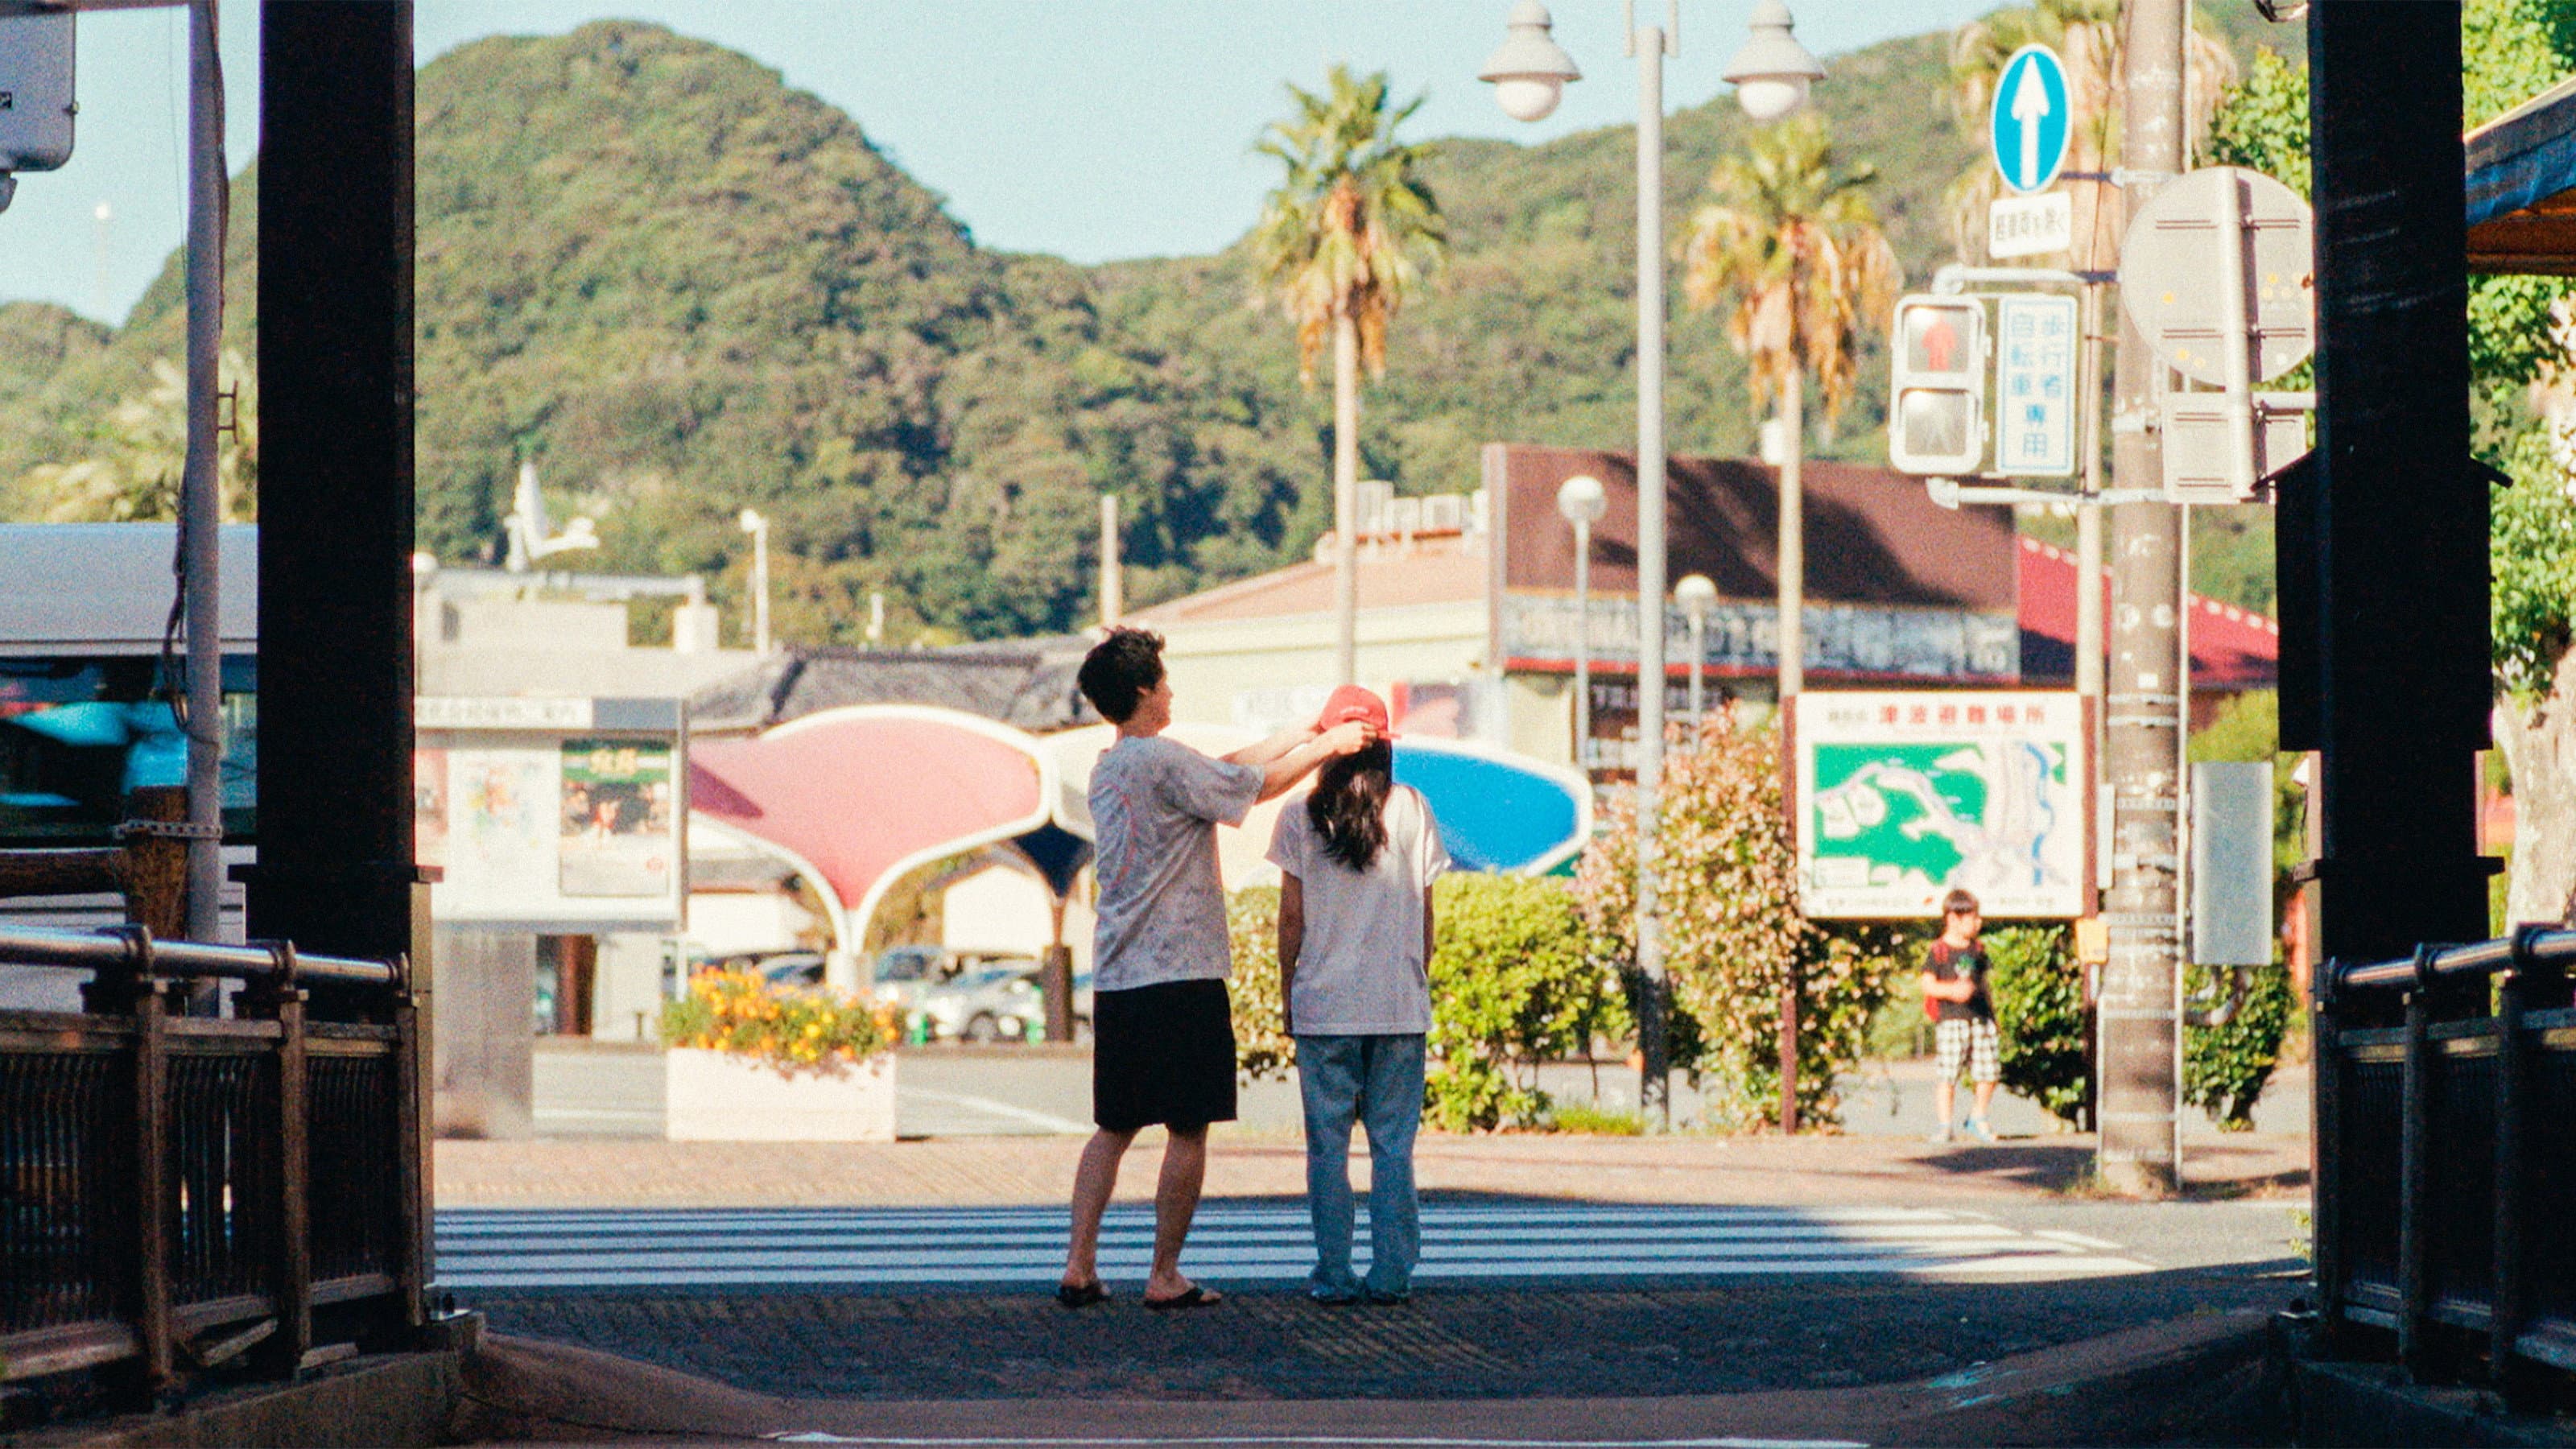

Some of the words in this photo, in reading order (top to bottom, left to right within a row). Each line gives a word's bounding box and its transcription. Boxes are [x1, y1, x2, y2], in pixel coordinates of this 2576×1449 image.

[2013, 313, 2033, 396] 自転車
[2041, 314, 2062, 398] 歩行者
[2024, 404, 2047, 457] 専用
[1879, 704, 2046, 723] 津波避難場所
